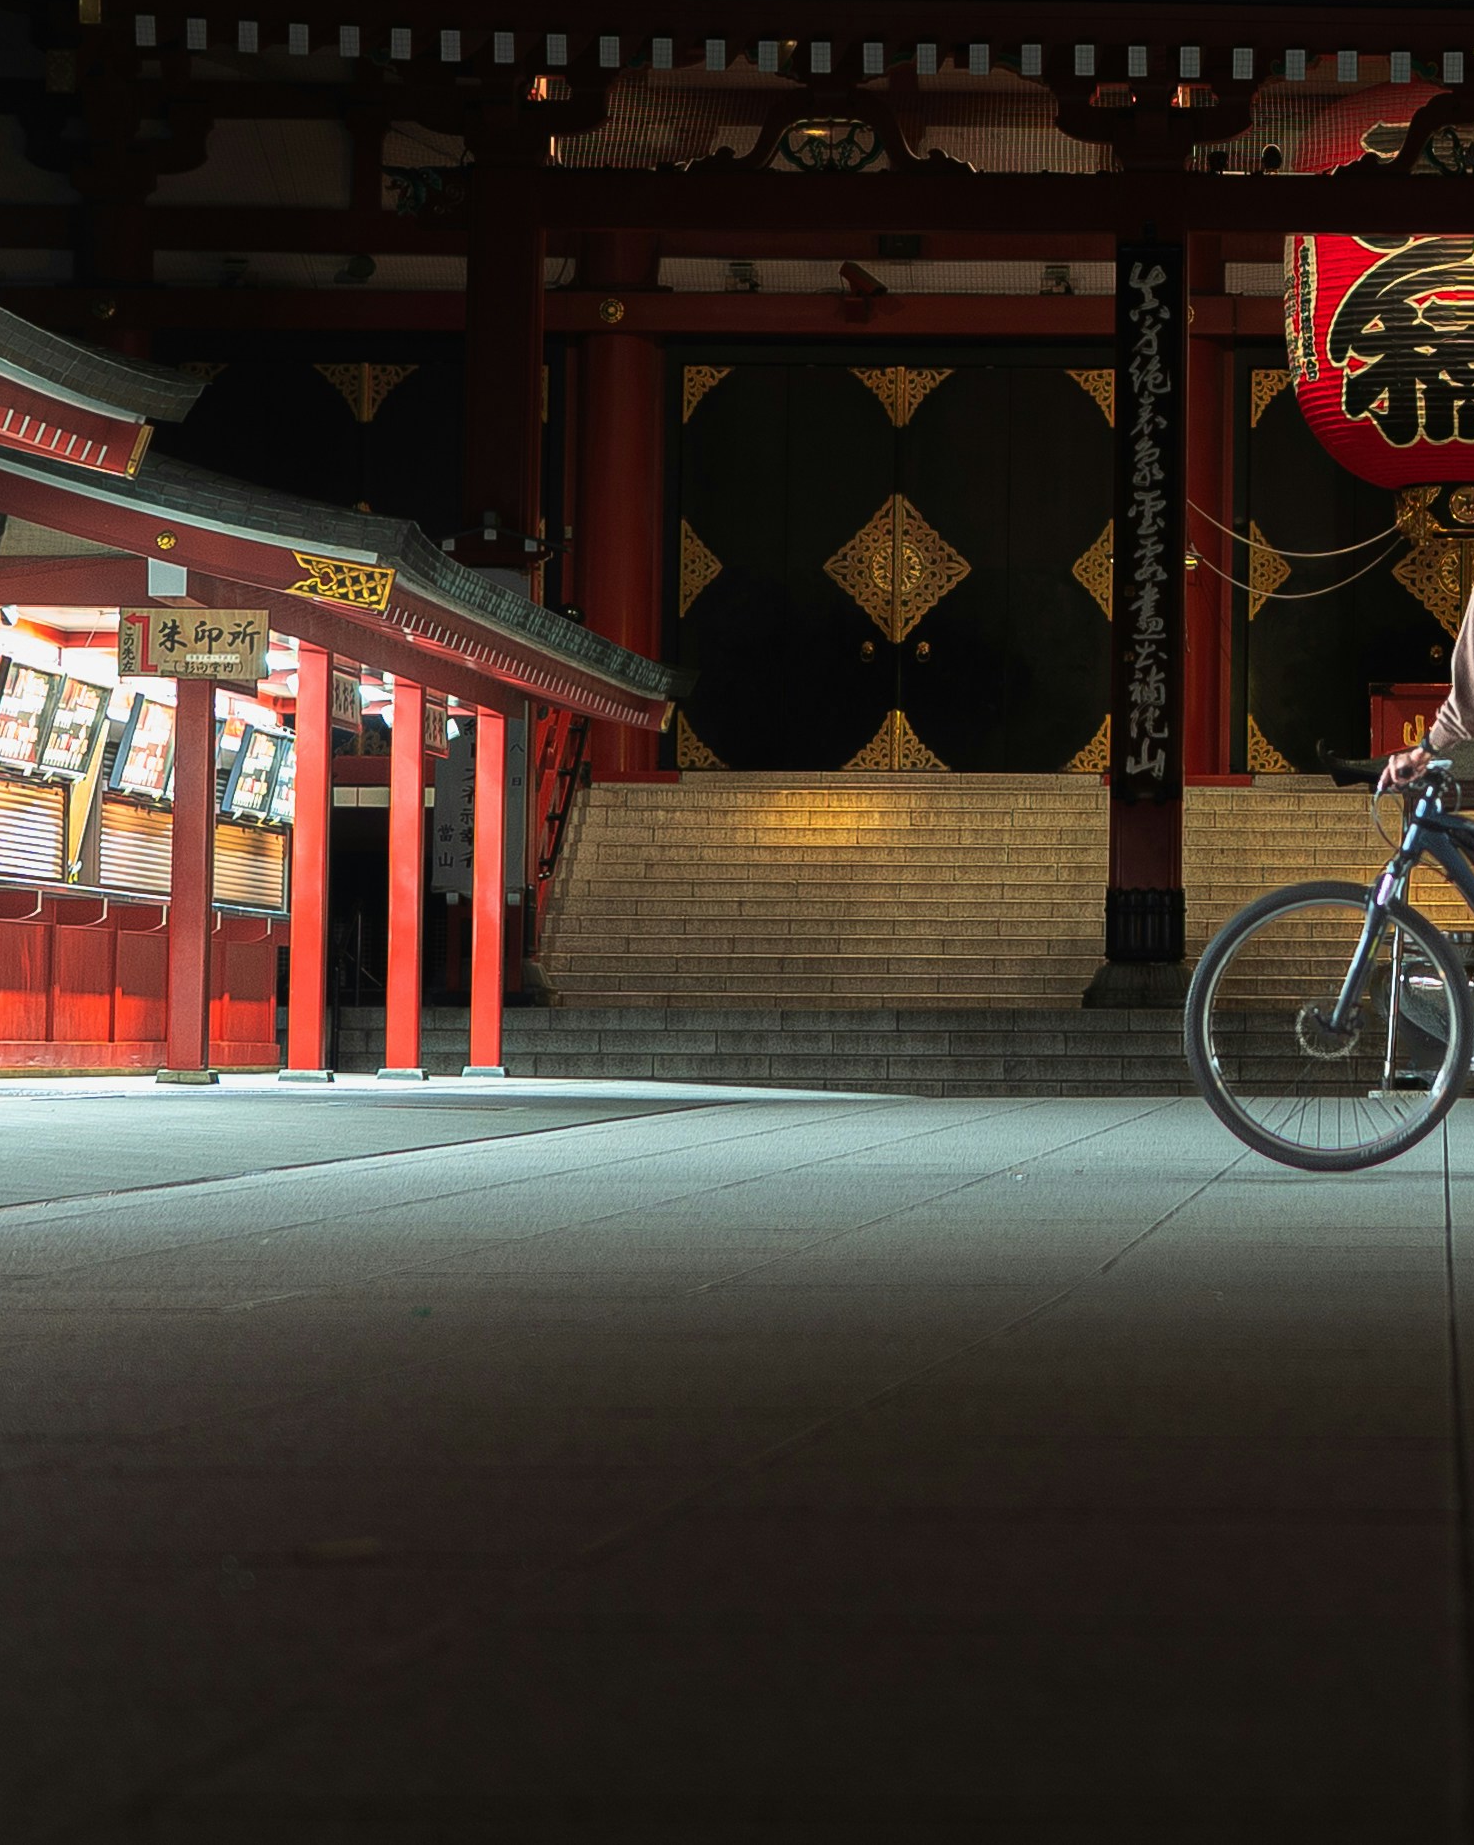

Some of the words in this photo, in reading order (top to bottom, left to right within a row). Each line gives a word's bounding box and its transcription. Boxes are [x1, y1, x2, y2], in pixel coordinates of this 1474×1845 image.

[122, 627, 136, 673] この先左
[158, 618, 261, 655] 朱印所
